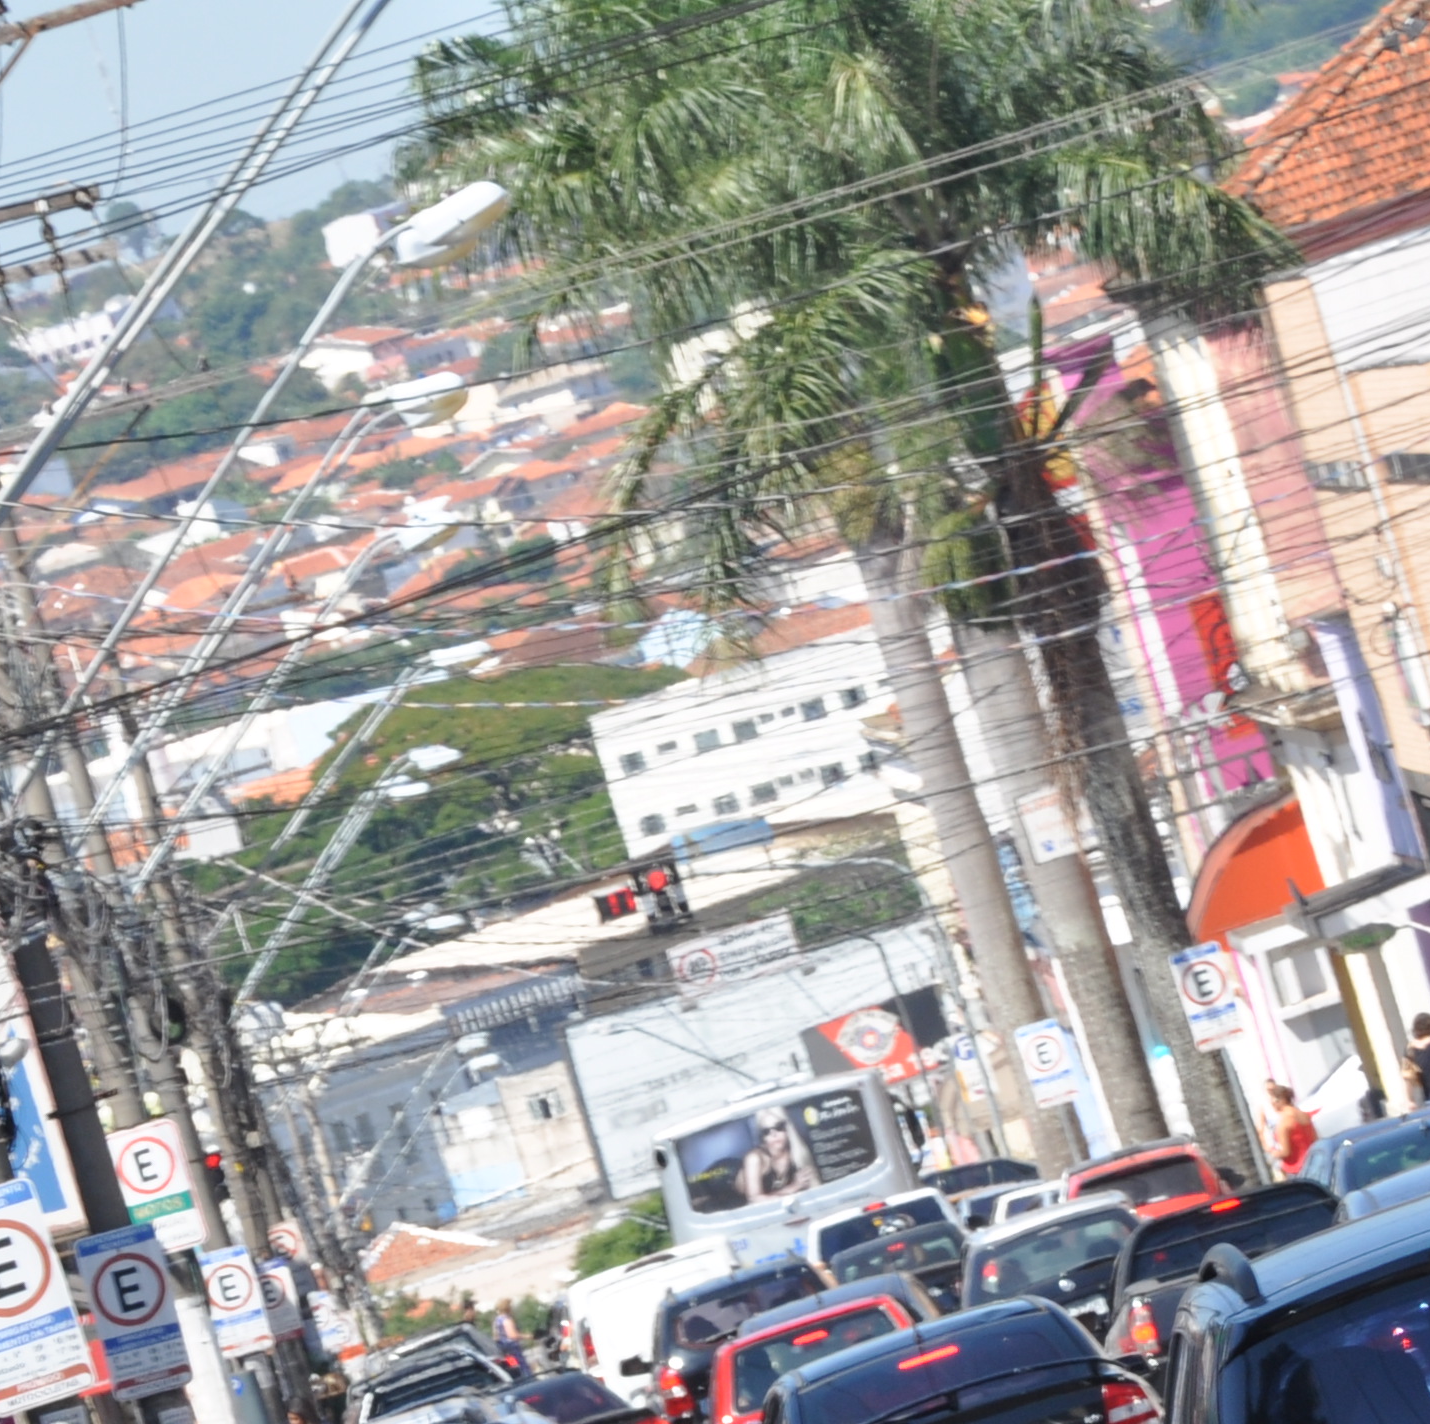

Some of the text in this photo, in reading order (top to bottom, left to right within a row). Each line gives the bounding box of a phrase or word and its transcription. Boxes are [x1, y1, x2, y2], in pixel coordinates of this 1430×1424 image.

[1191, 970, 1217, 998] E
[134, 1148, 158, 1182] E
[111, 1266, 146, 1313] E
[218, 1273, 241, 1302] E
